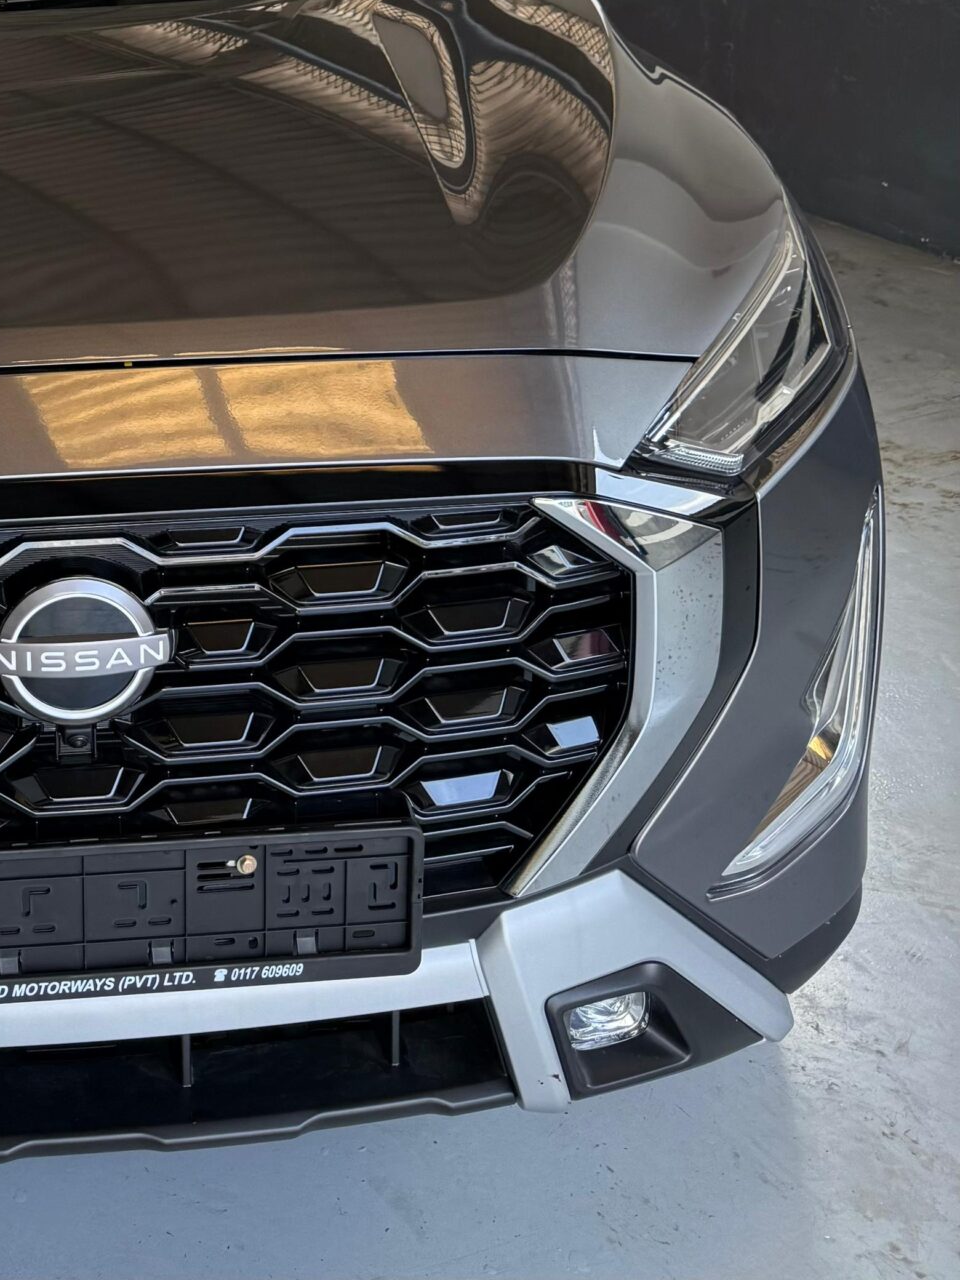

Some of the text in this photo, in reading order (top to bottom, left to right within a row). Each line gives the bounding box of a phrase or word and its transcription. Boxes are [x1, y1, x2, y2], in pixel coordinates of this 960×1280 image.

[11, 976, 115, 998] MOTORWAYS
[118, 973, 161, 992] (PVT)
[163, 971, 197, 987] LTD.
[230, 965, 259, 981] 0117
[261, 962, 305, 979] 609609
